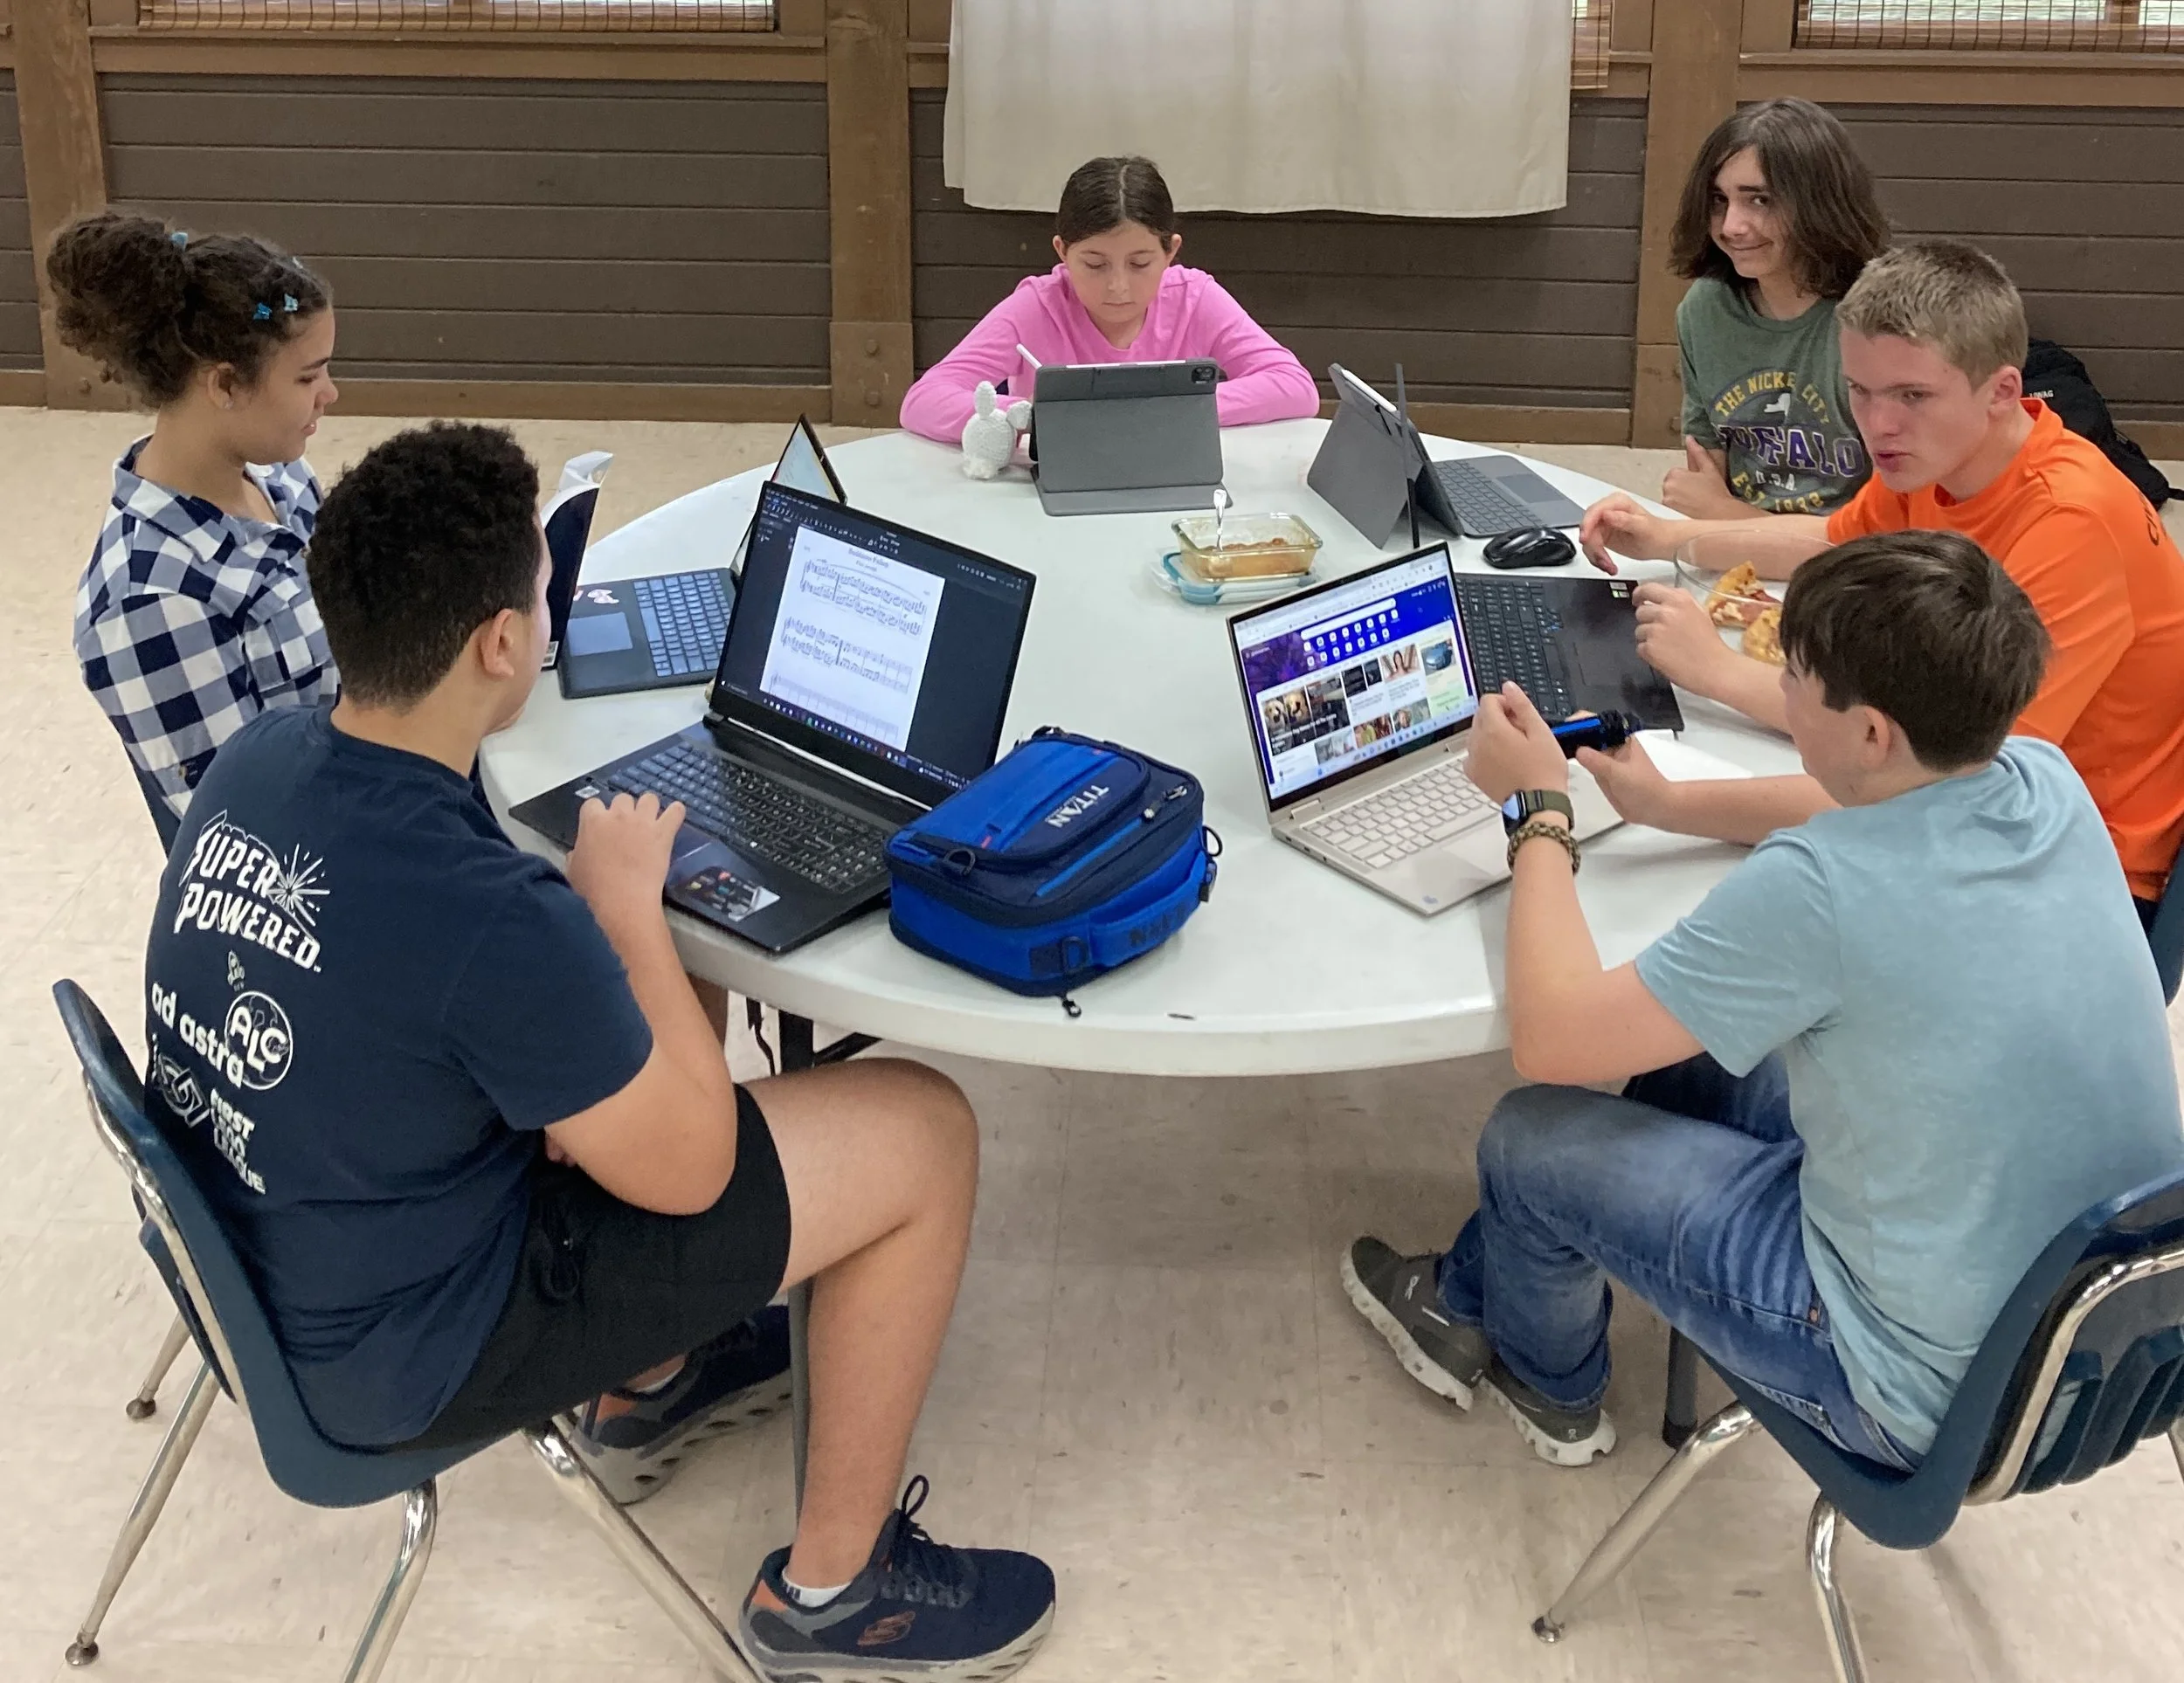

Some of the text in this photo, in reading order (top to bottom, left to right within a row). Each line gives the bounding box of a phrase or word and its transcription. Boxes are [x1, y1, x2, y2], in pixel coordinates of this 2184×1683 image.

[1715, 383, 1745, 416] THE
[1747, 371, 1797, 394] NICKE
[1044, 784, 1109, 828] TITAN
[178, 818, 281, 899] SUPER
[151, 983, 177, 1030] ad
[179, 1012, 245, 1089] astra
[230, 1005, 287, 1073] ALC
[211, 1088, 256, 1140] FIRST
